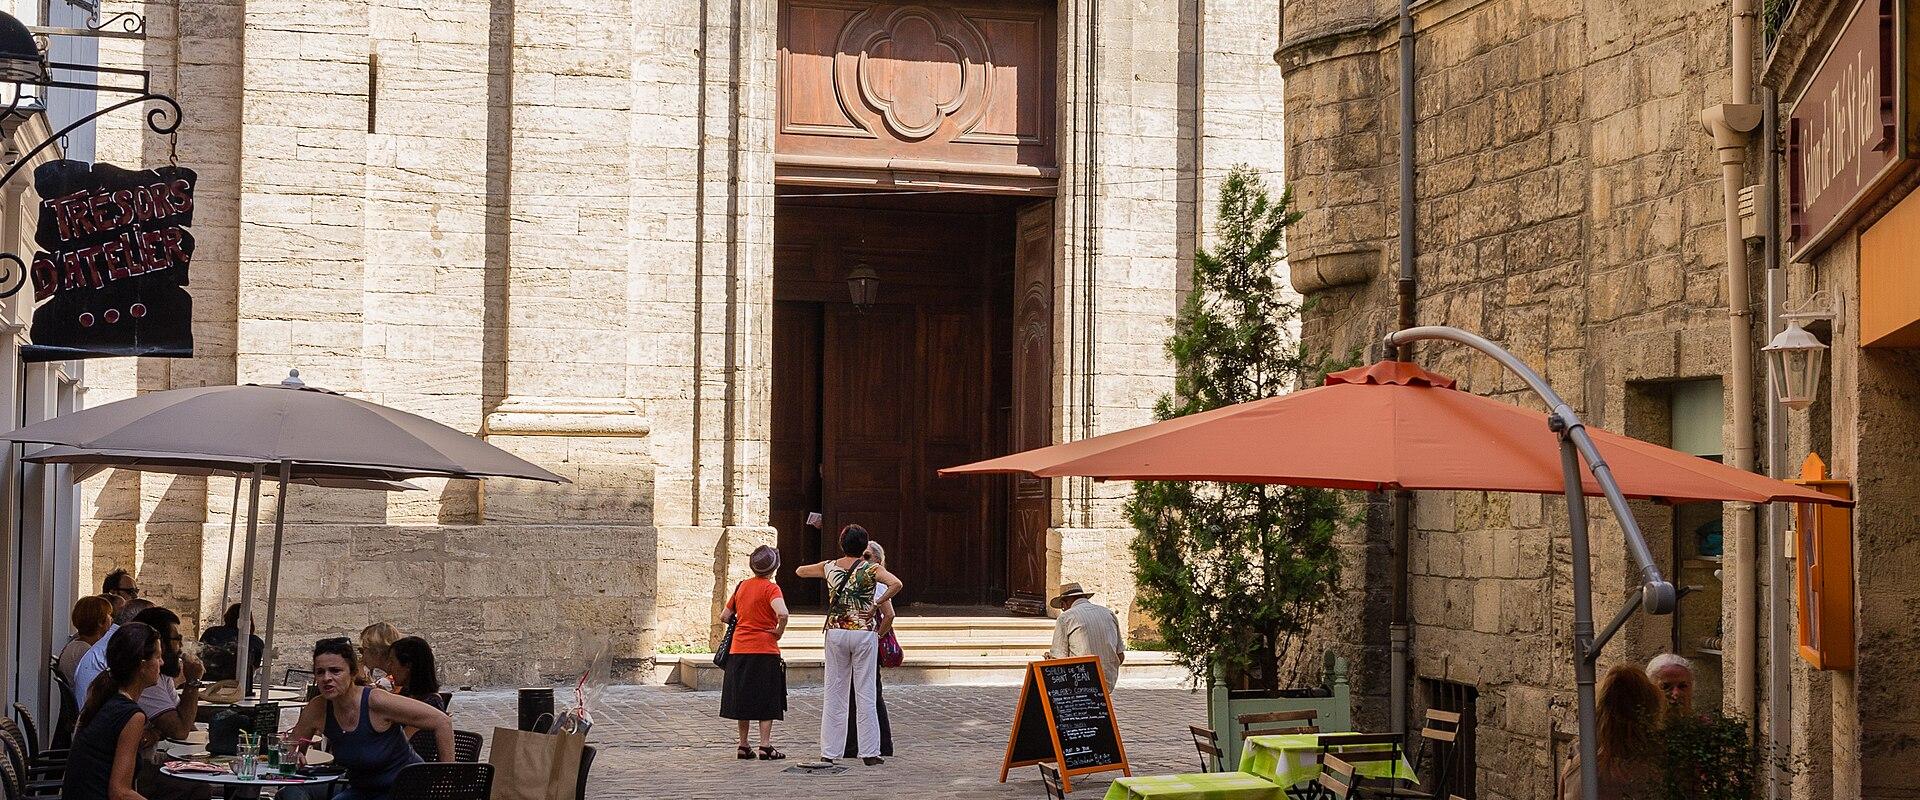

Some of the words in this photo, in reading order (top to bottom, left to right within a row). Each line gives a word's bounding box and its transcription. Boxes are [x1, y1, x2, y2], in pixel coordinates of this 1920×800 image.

[1802, 118, 1822, 214] Salon
[1821, 98, 1831, 191] de
[1831, 68, 1847, 180] Thé
[1847, 63, 1857, 164] St
[44, 178, 194, 243] TRÉSORS
[30, 223, 191, 304] D'ATELIER
[1072, 671, 1091, 687] JEAN
